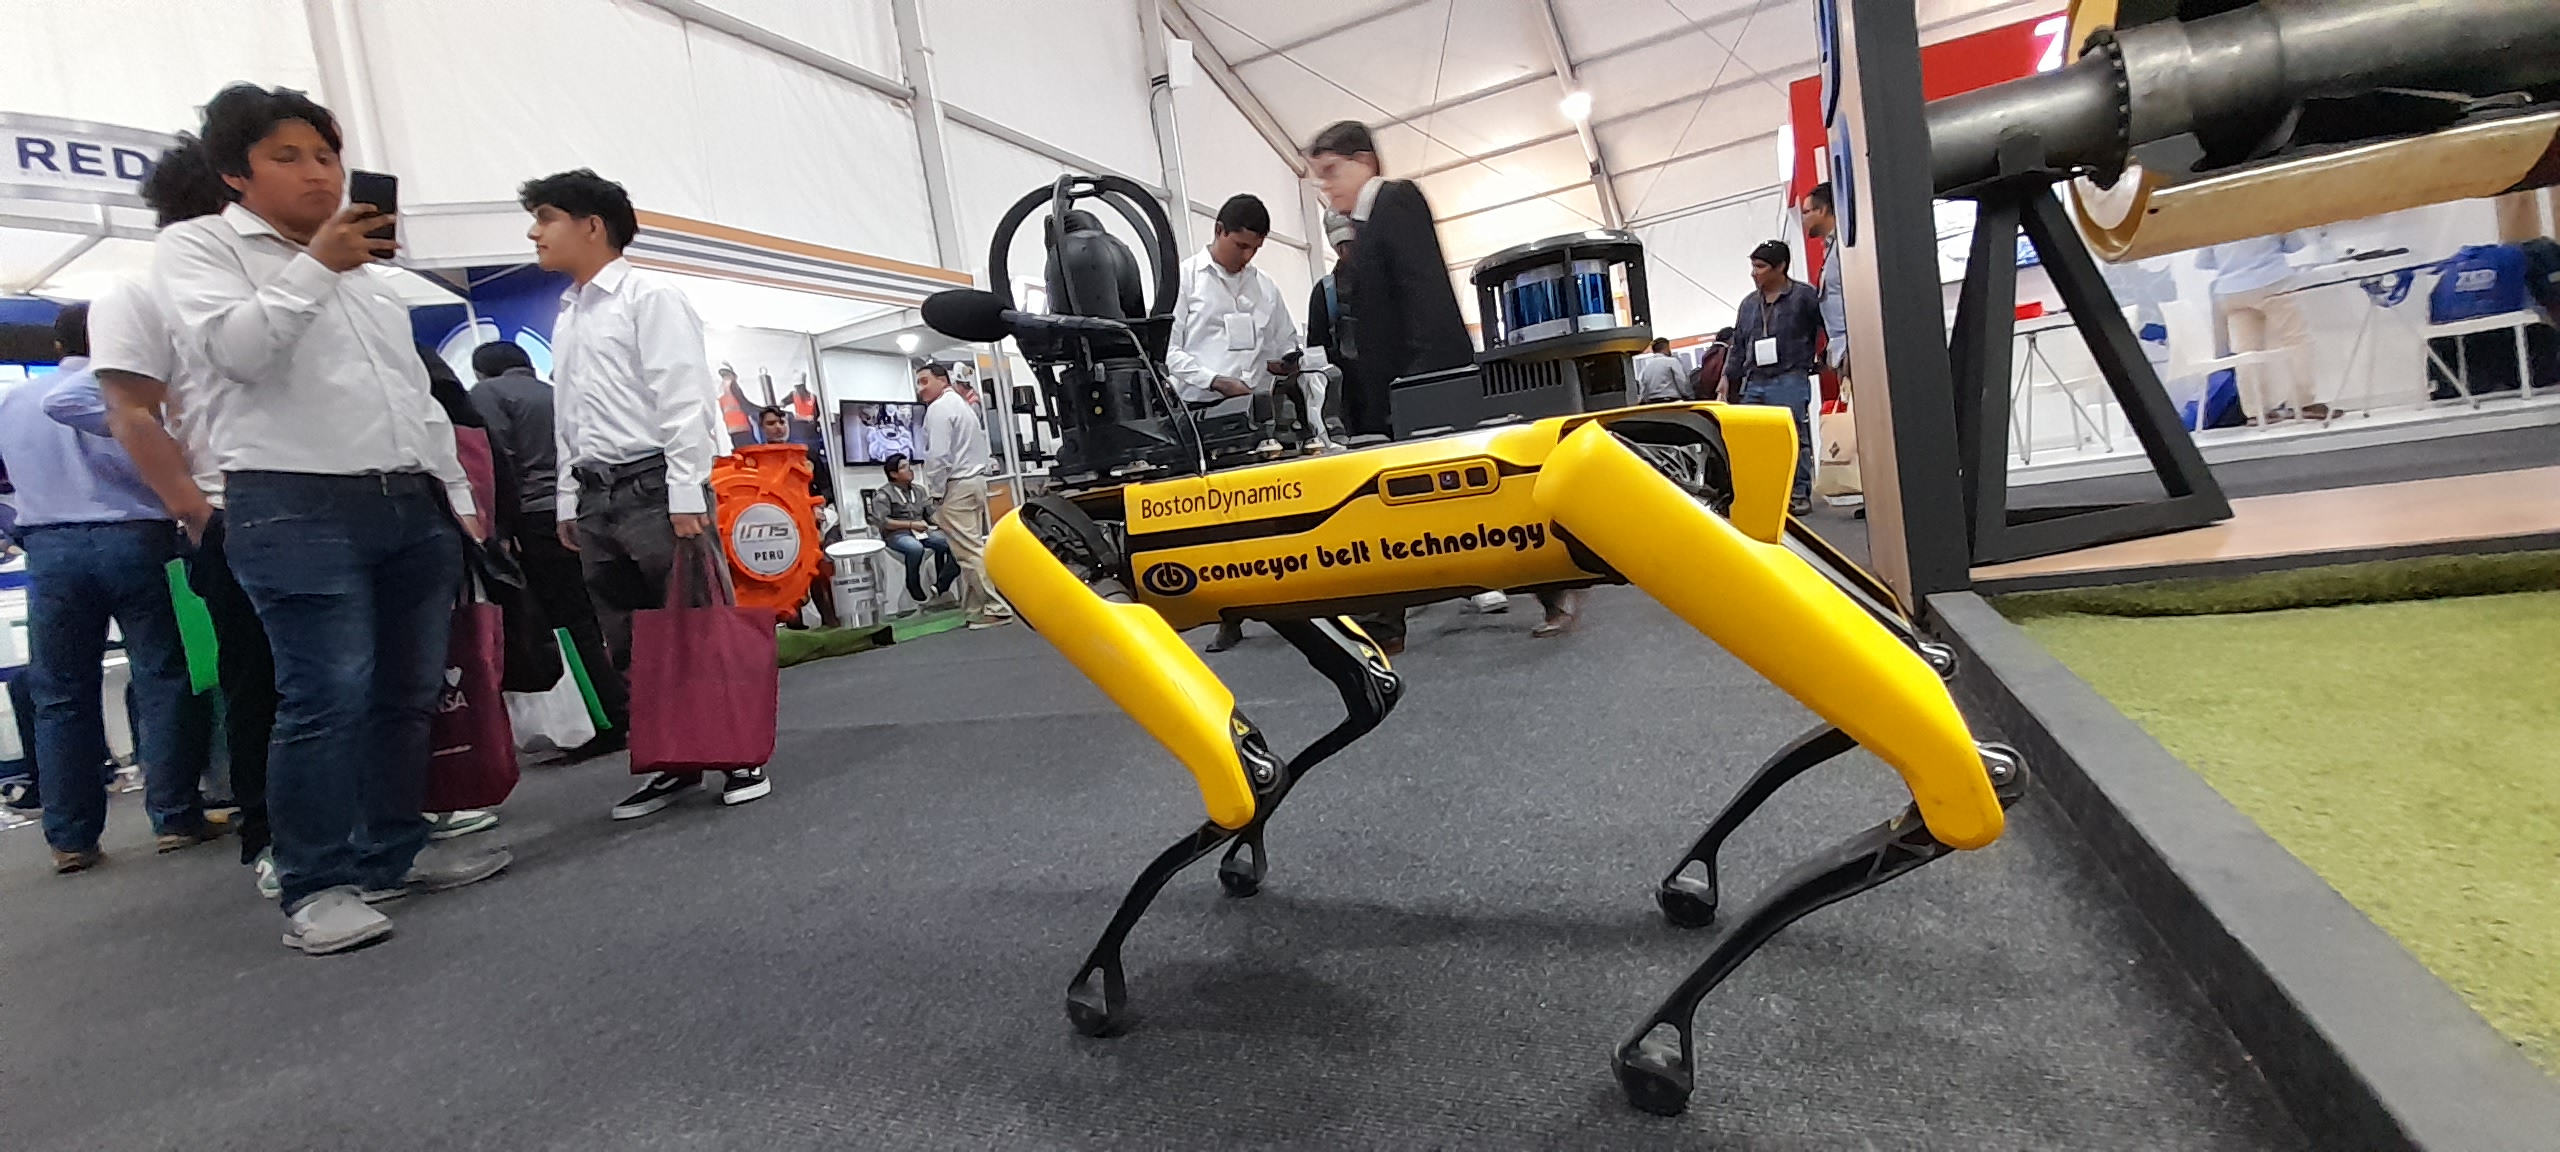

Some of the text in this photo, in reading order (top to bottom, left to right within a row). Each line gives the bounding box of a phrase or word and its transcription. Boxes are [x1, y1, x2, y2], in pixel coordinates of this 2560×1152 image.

[1198, 553, 1309, 581] conveyor
[1316, 545, 1371, 568] belt
[1379, 523, 1546, 561] technology
